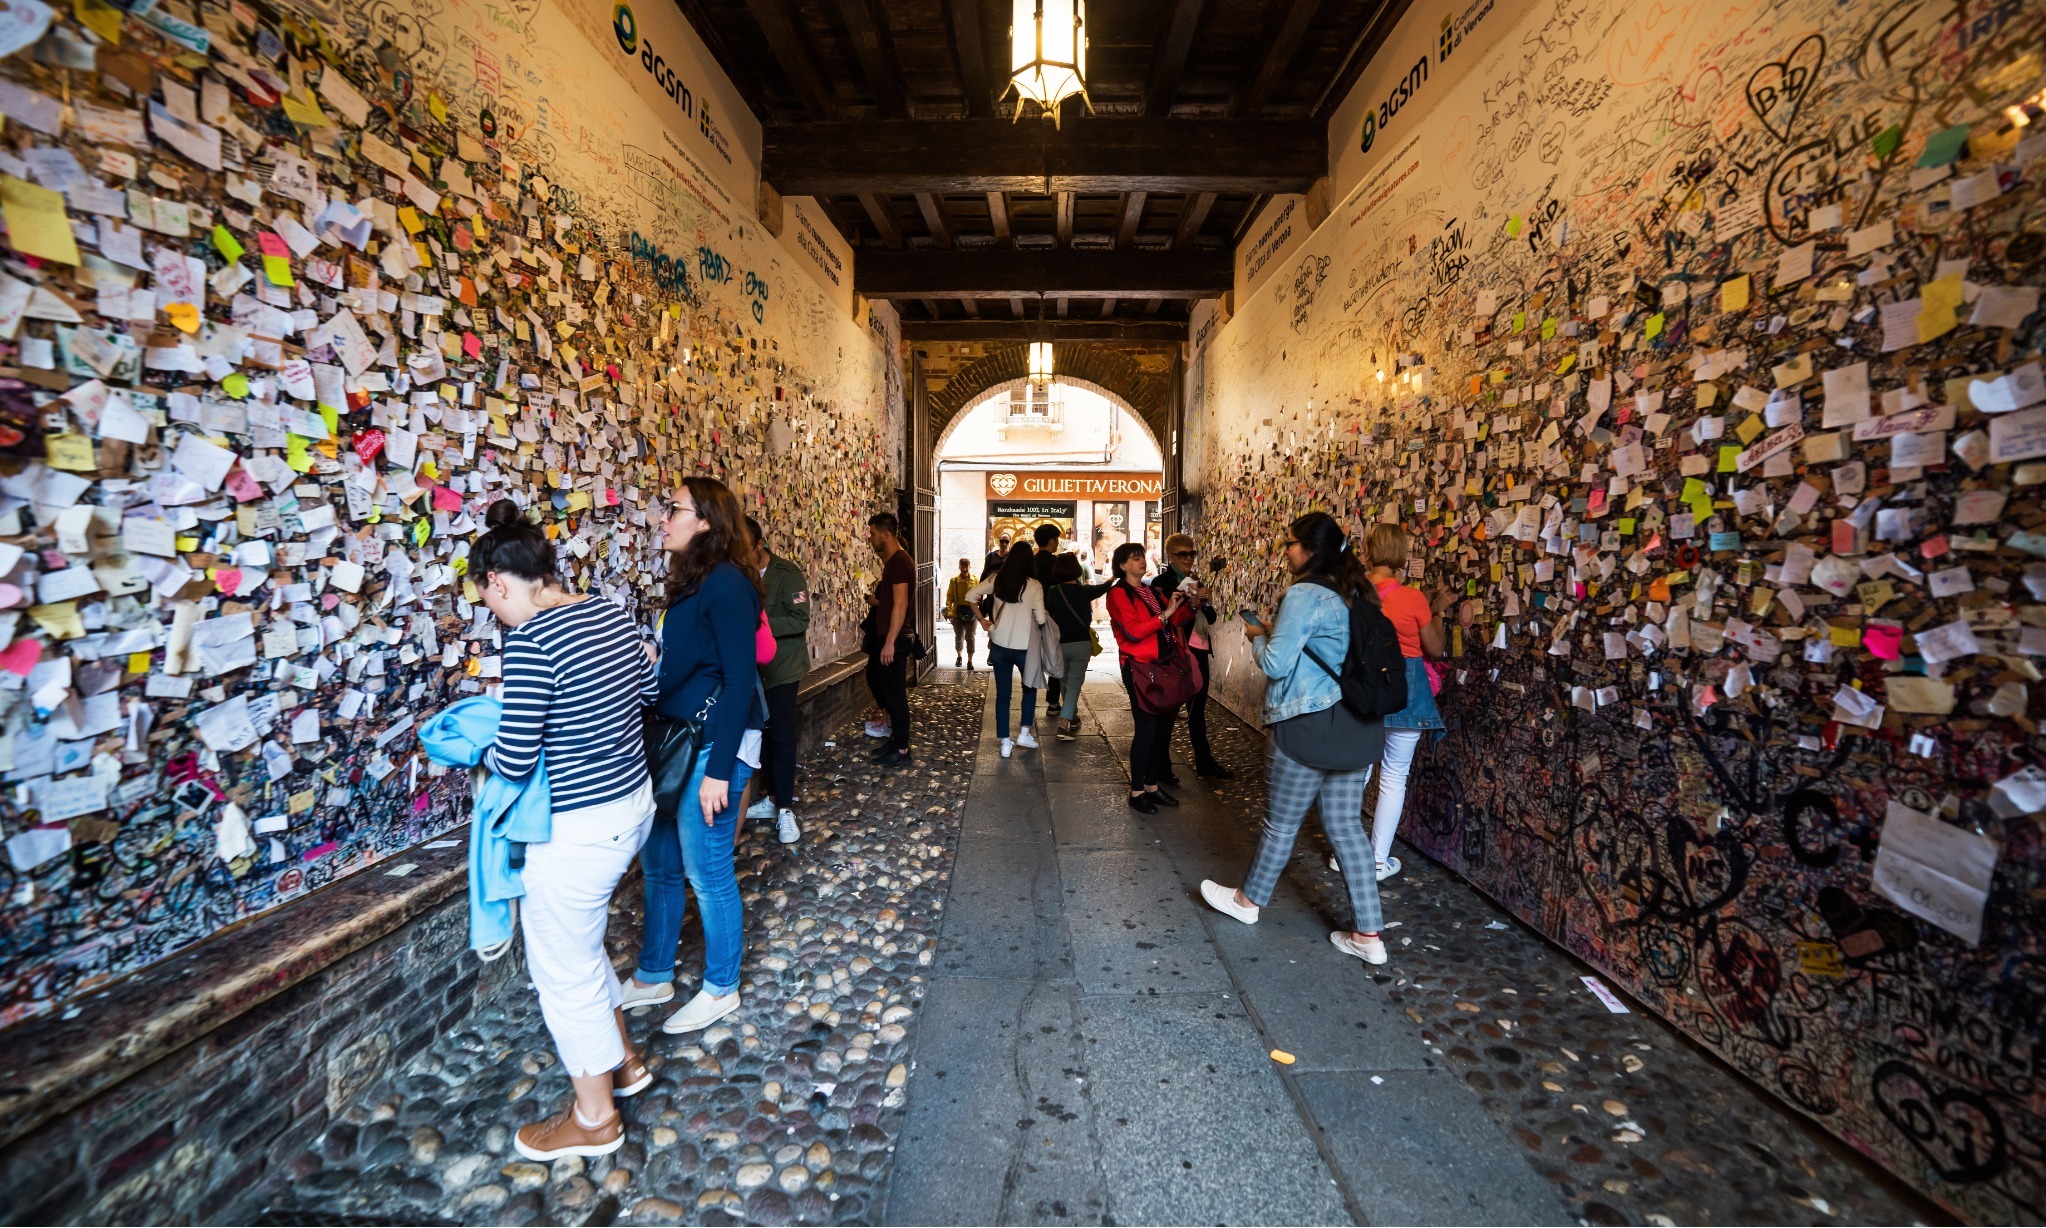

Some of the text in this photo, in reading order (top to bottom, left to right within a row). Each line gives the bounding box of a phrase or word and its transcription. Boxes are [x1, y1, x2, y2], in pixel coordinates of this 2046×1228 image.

[1454, 0, 1494, 48] di Verona
[715, 139, 732, 165] Verona
[796, 203, 842, 271] Diamo nuova energia
[797, 231, 807, 250] alla
[819, 255, 823, 268] di
[824, 260, 839, 286] Verona
[1245, 199, 1295, 267] Diamo nuova energia
[1272, 225, 1292, 254] Verona
